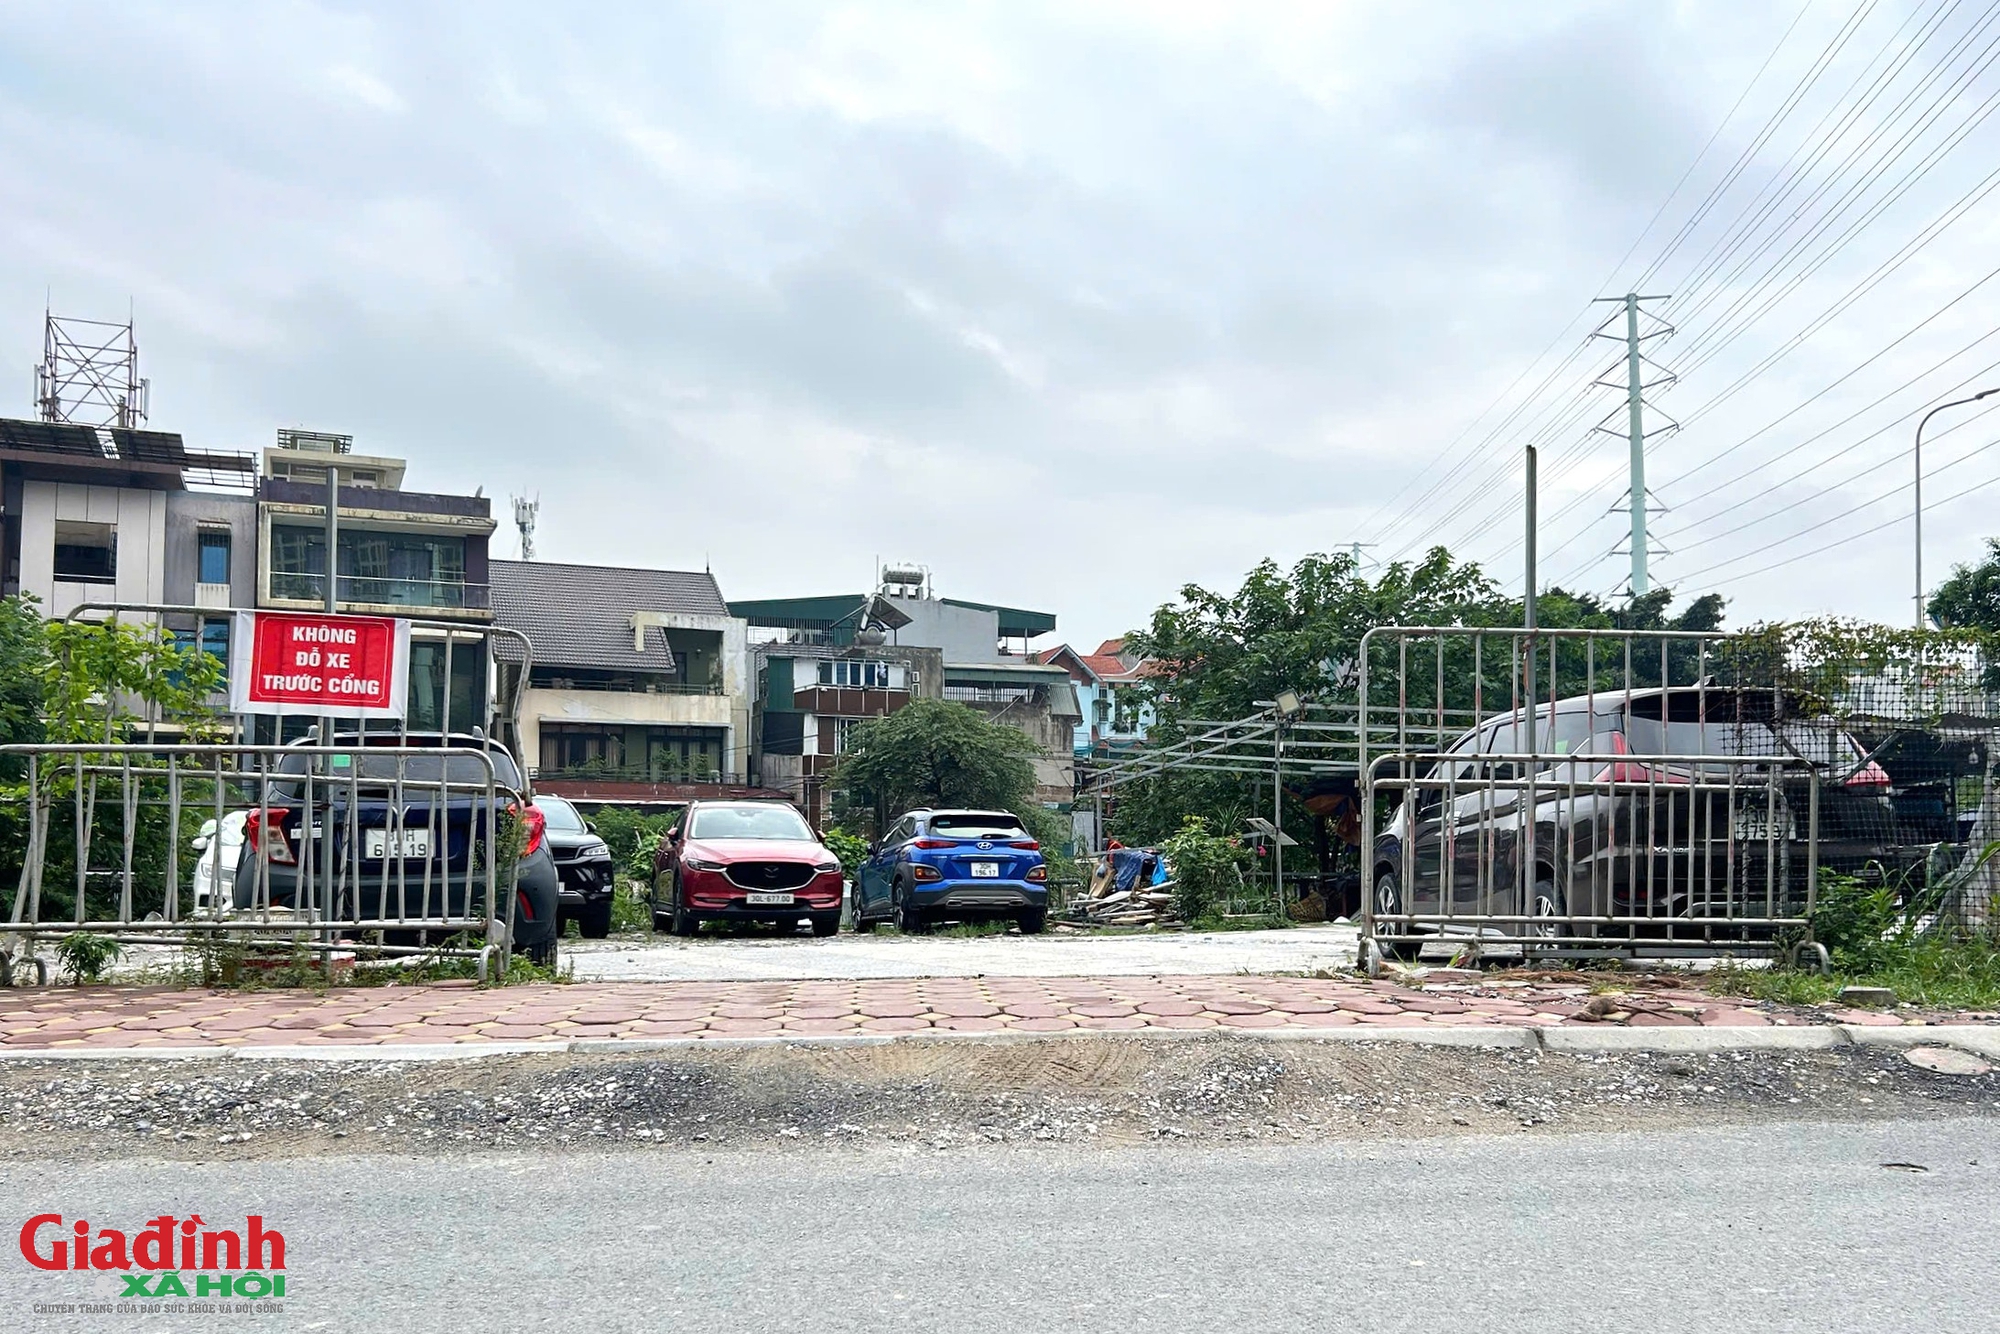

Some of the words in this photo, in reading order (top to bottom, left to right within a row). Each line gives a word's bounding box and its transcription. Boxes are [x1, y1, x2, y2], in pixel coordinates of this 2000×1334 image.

[292, 624, 357, 644] KHÔNG
[295, 646, 321, 667] ĐỖ
[326, 653, 351, 669] XE
[263, 674, 322, 692] TRƯỚC
[328, 673, 380, 695] CỔNG
